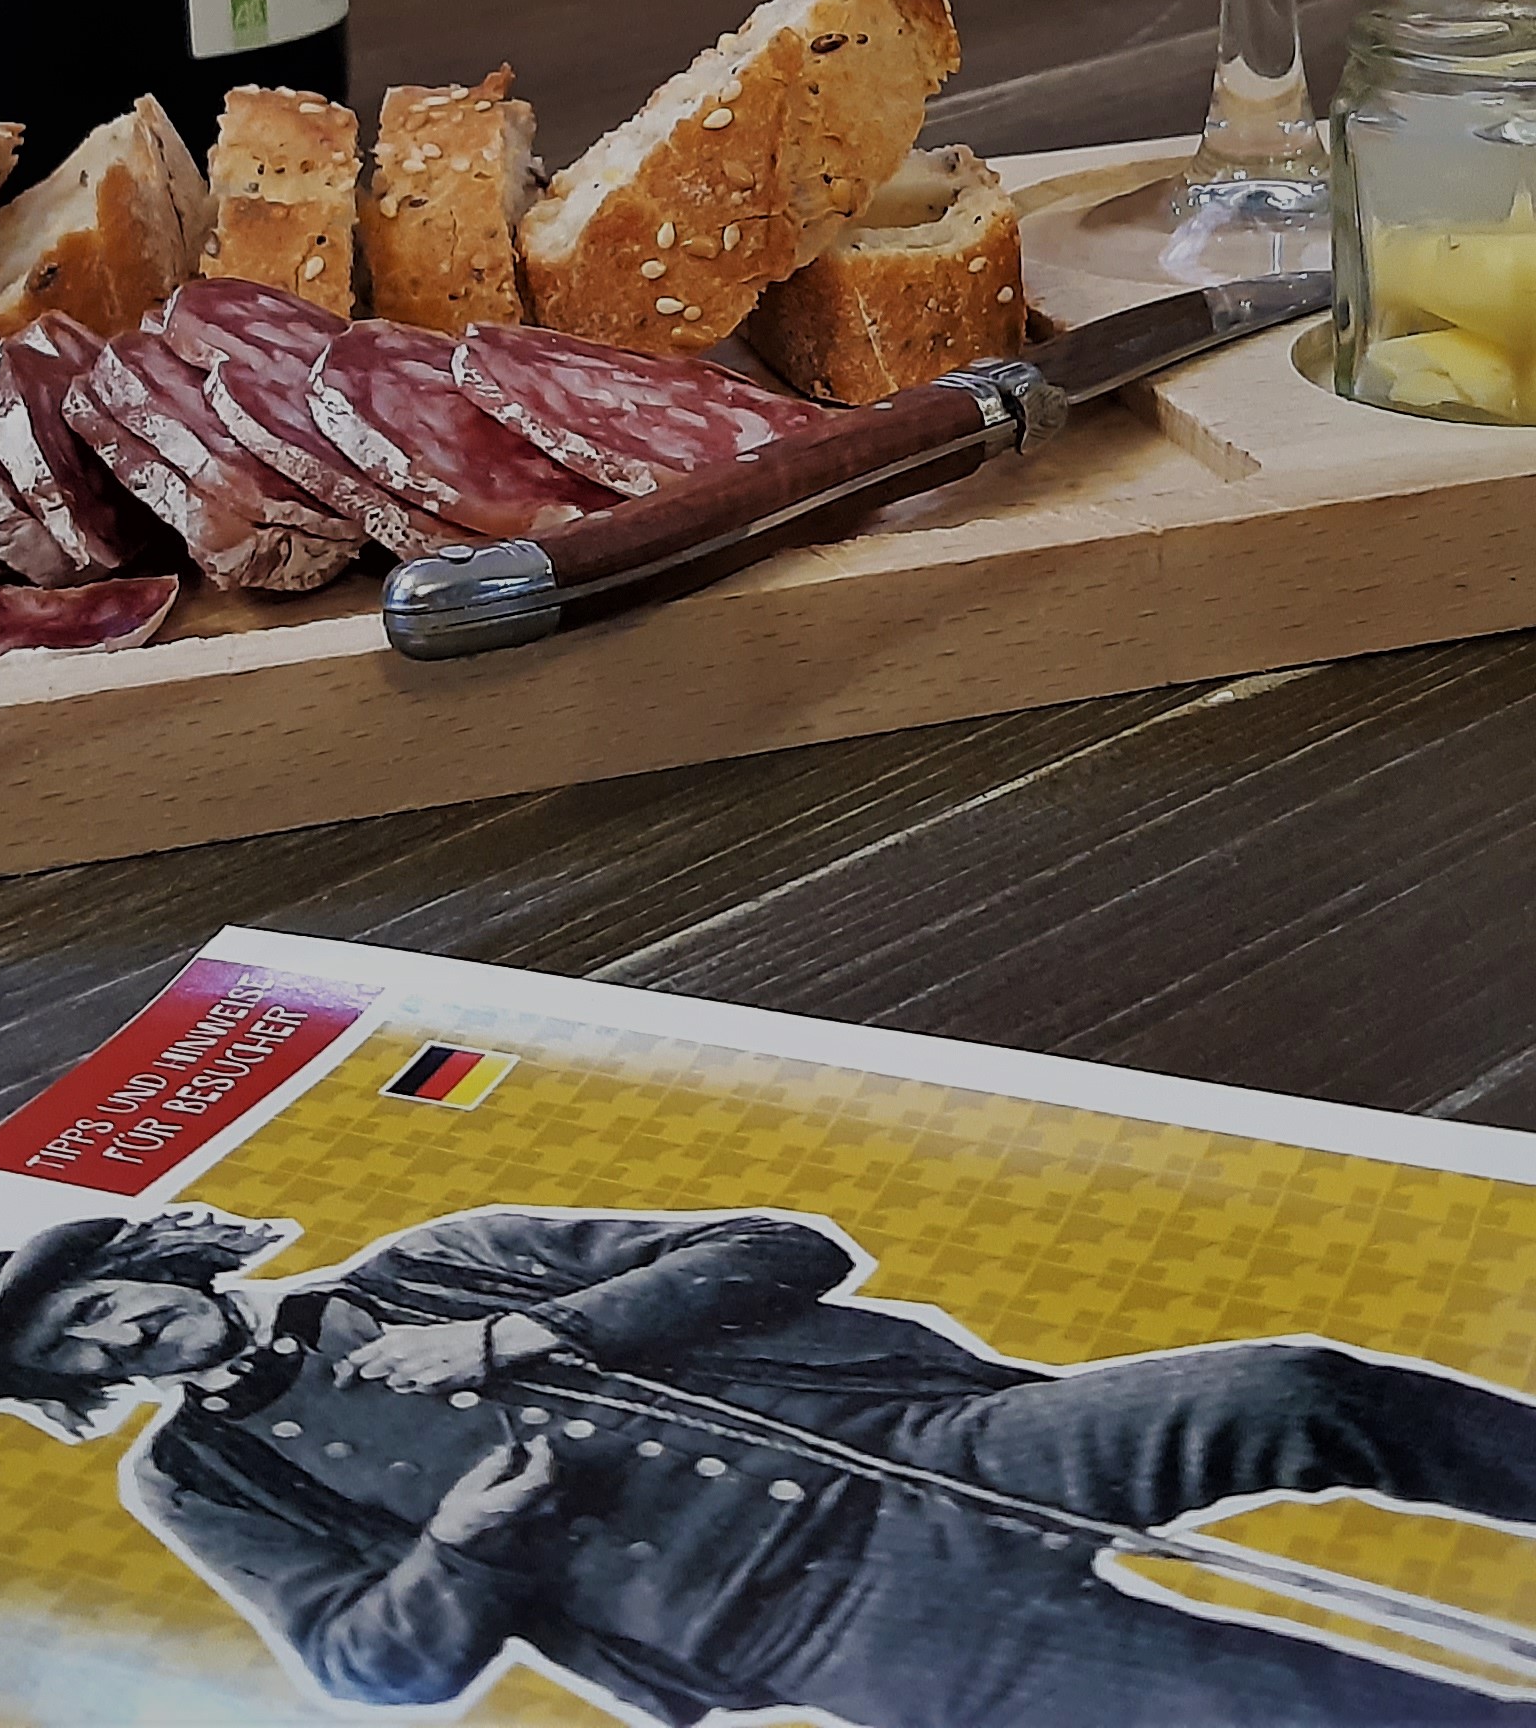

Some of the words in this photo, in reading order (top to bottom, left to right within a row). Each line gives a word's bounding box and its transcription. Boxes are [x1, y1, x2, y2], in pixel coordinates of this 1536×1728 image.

[25, 1116, 115, 1170] TIPPS
[96, 1072, 168, 1116] UND
[152, 971, 276, 1071] HINWEISE
[103, 1116, 184, 1166] FÜR
[162, 1004, 309, 1116] BESUCHER
